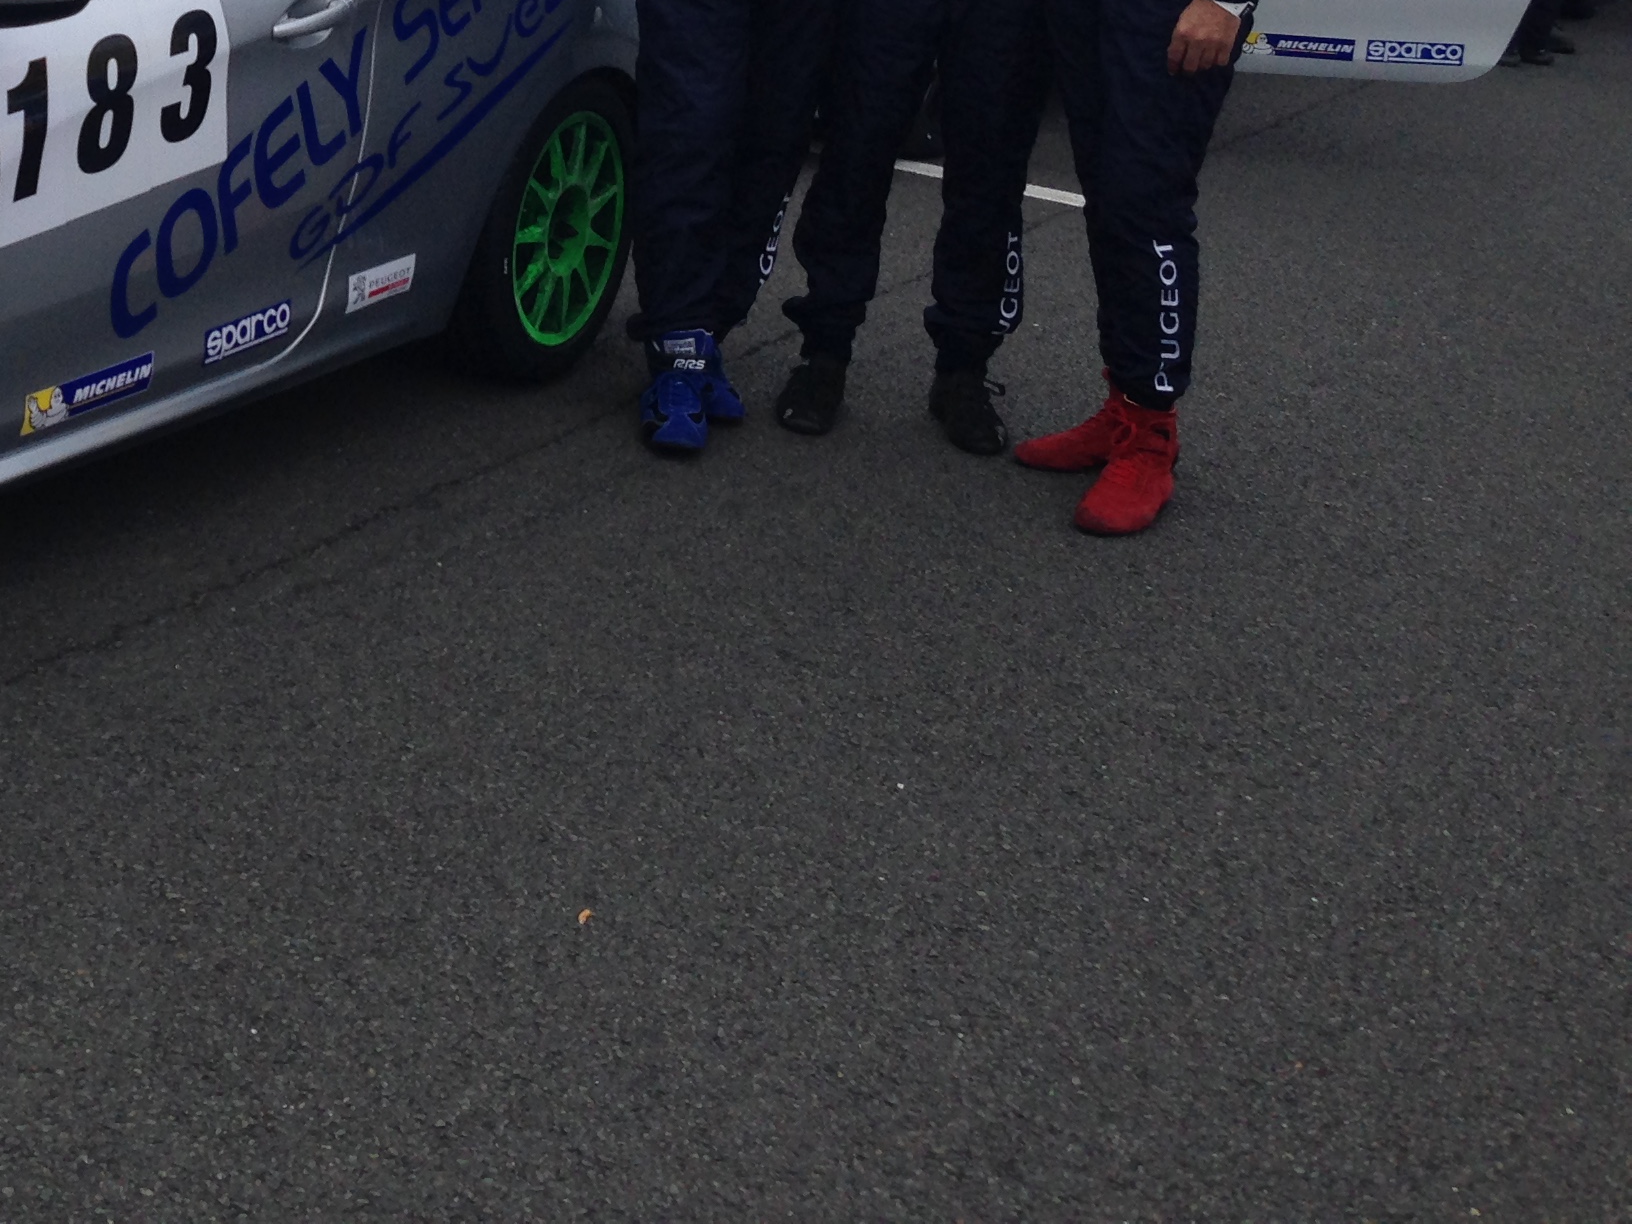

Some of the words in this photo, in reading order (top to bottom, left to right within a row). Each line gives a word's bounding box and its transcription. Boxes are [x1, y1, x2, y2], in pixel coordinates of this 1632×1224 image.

[1276, 39, 1354, 54] MICHELIN
[1369, 41, 1462, 62] sparco
[5, 8, 219, 204] 183
[109, 27, 368, 339] COFELY
[991, 231, 1020, 336] UGEOT
[206, 301, 292, 359] sparco
[1152, 239, 1181, 393] PUGEOT
[72, 363, 152, 404] MICHELIN
[673, 358, 706, 370] RRS
